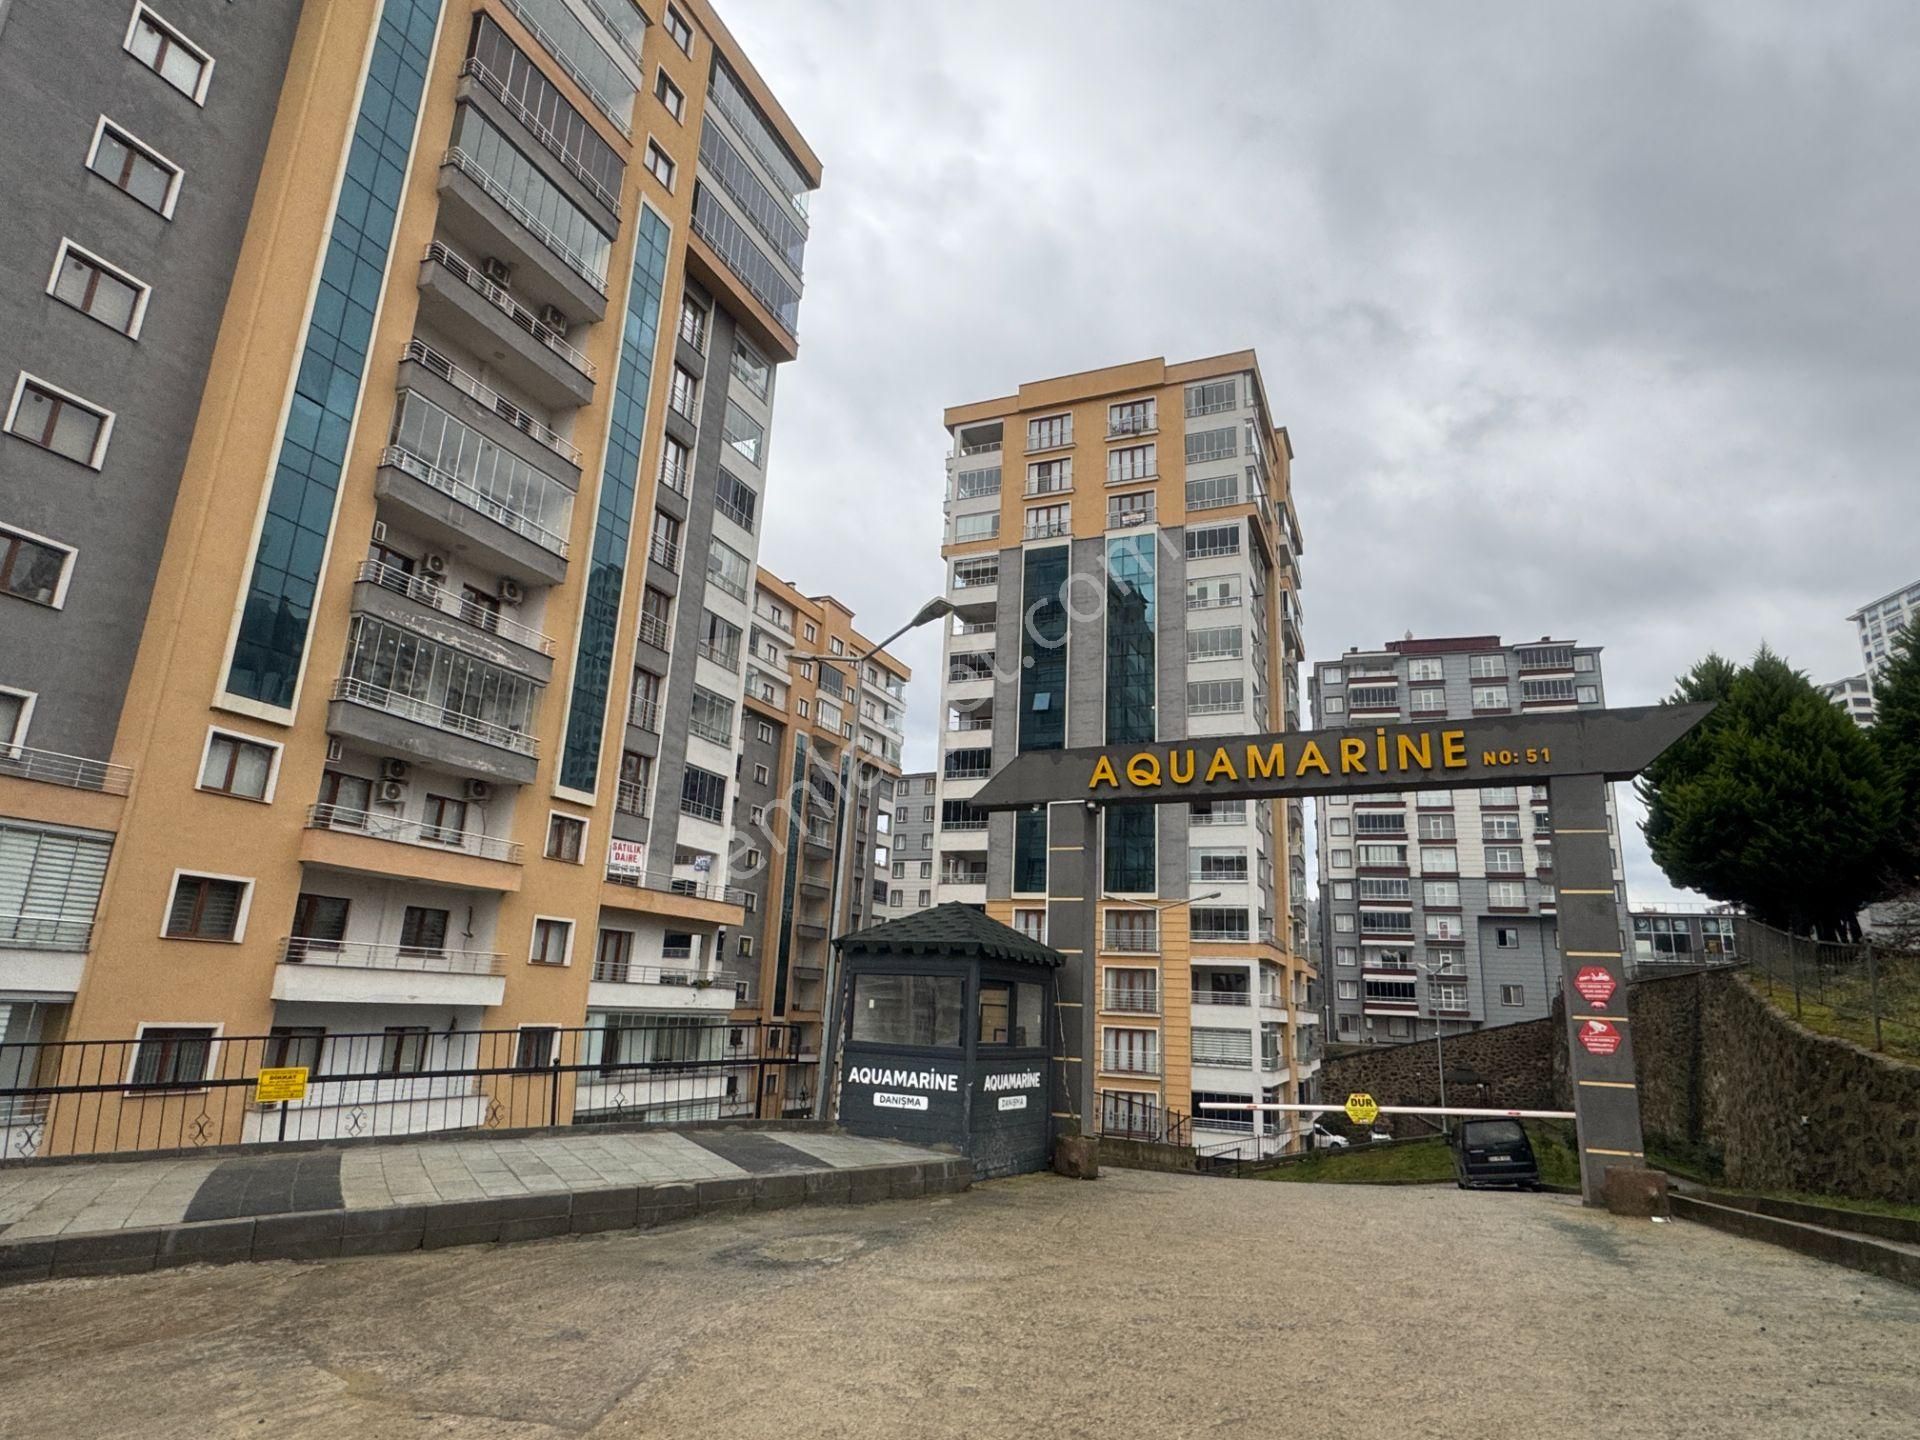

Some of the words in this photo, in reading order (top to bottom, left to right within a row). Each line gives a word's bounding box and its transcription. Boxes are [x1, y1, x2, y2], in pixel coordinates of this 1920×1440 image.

[1088, 728, 1468, 789] AQUAMARİNE
[1483, 750, 1520, 766] NO:
[1526, 747, 1551, 764] 51
[612, 842, 642, 855] SATILIK
[848, 1066, 959, 1092] AQUAMARİNE
[984, 1068, 1041, 1092] AQUAMARİNE
[879, 1095, 921, 1108] DANIŞMA
[1351, 1098, 1373, 1107] DUR
